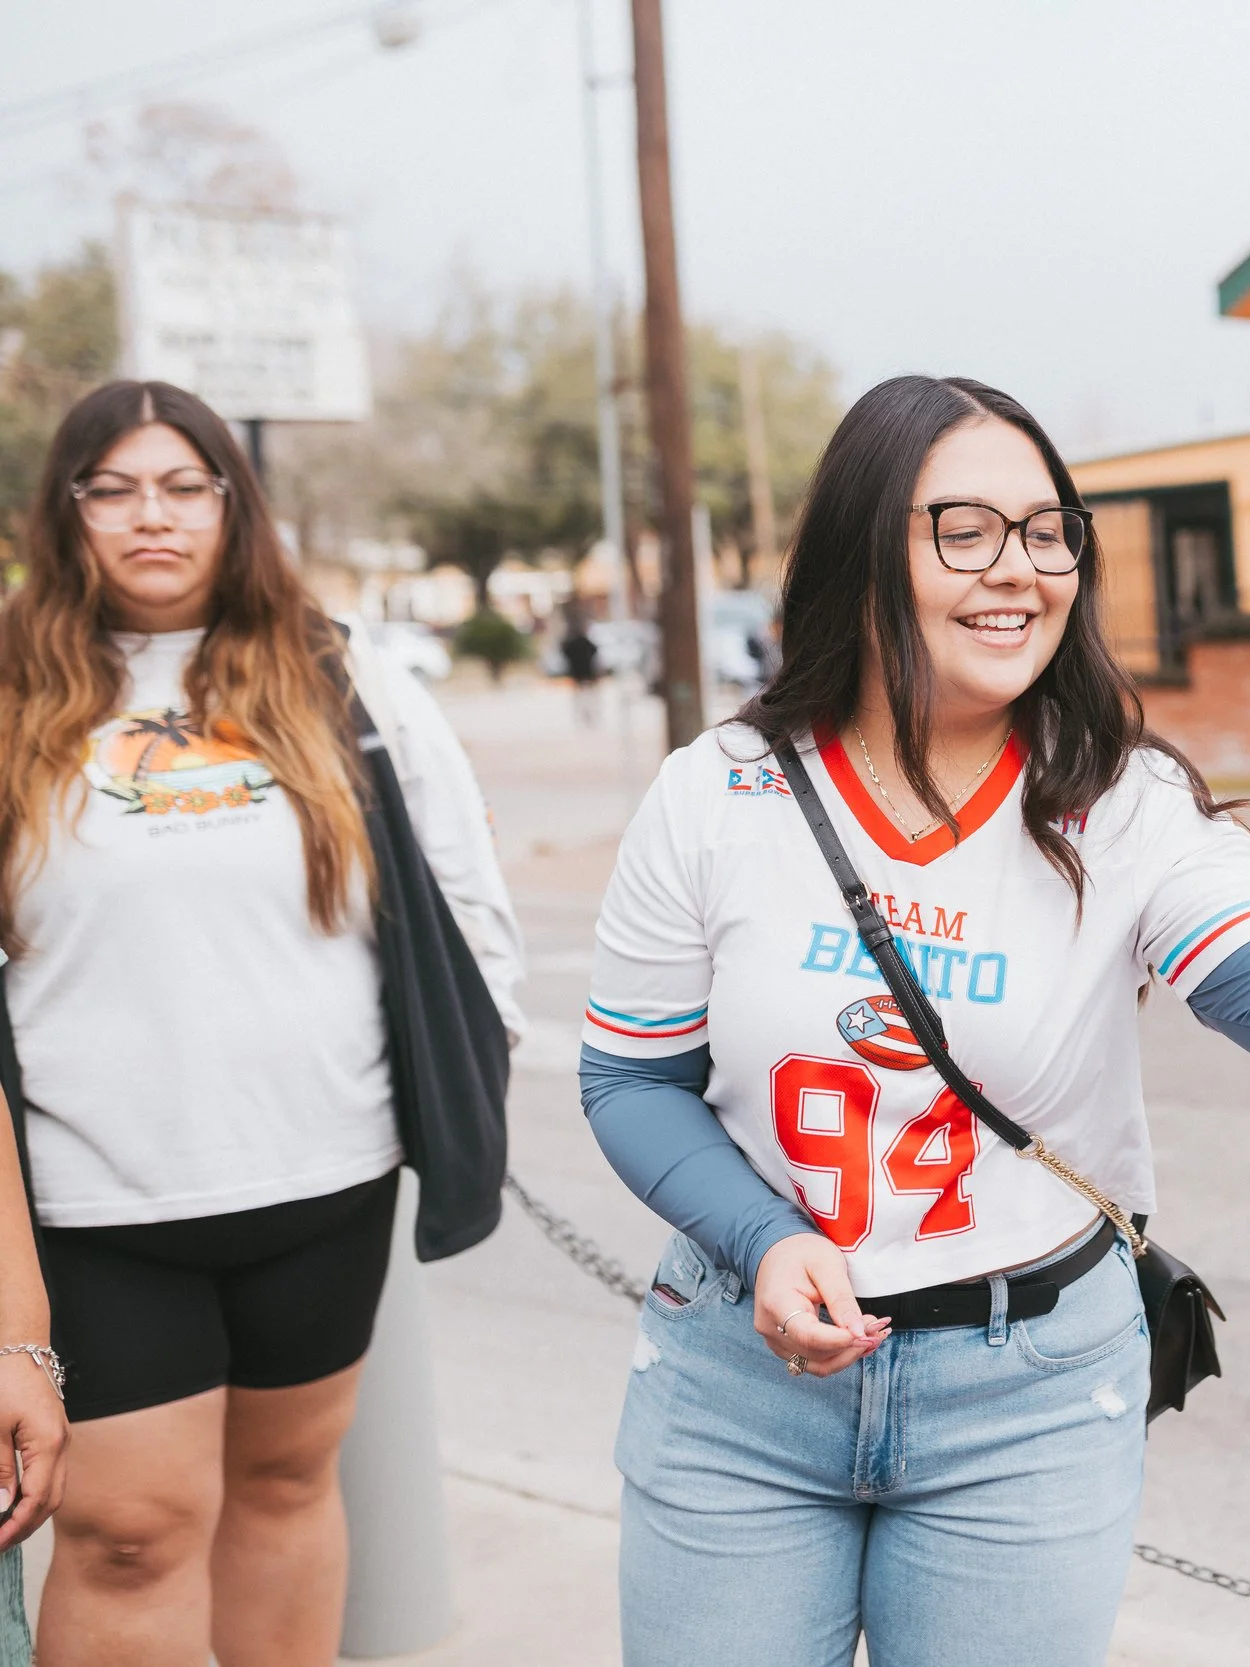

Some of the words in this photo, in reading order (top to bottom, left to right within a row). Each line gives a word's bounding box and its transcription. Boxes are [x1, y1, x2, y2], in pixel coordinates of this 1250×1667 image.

[147, 822, 191, 838] BAD
[194, 813, 261, 832] BUNNY
[769, 1053, 982, 1252] 94
